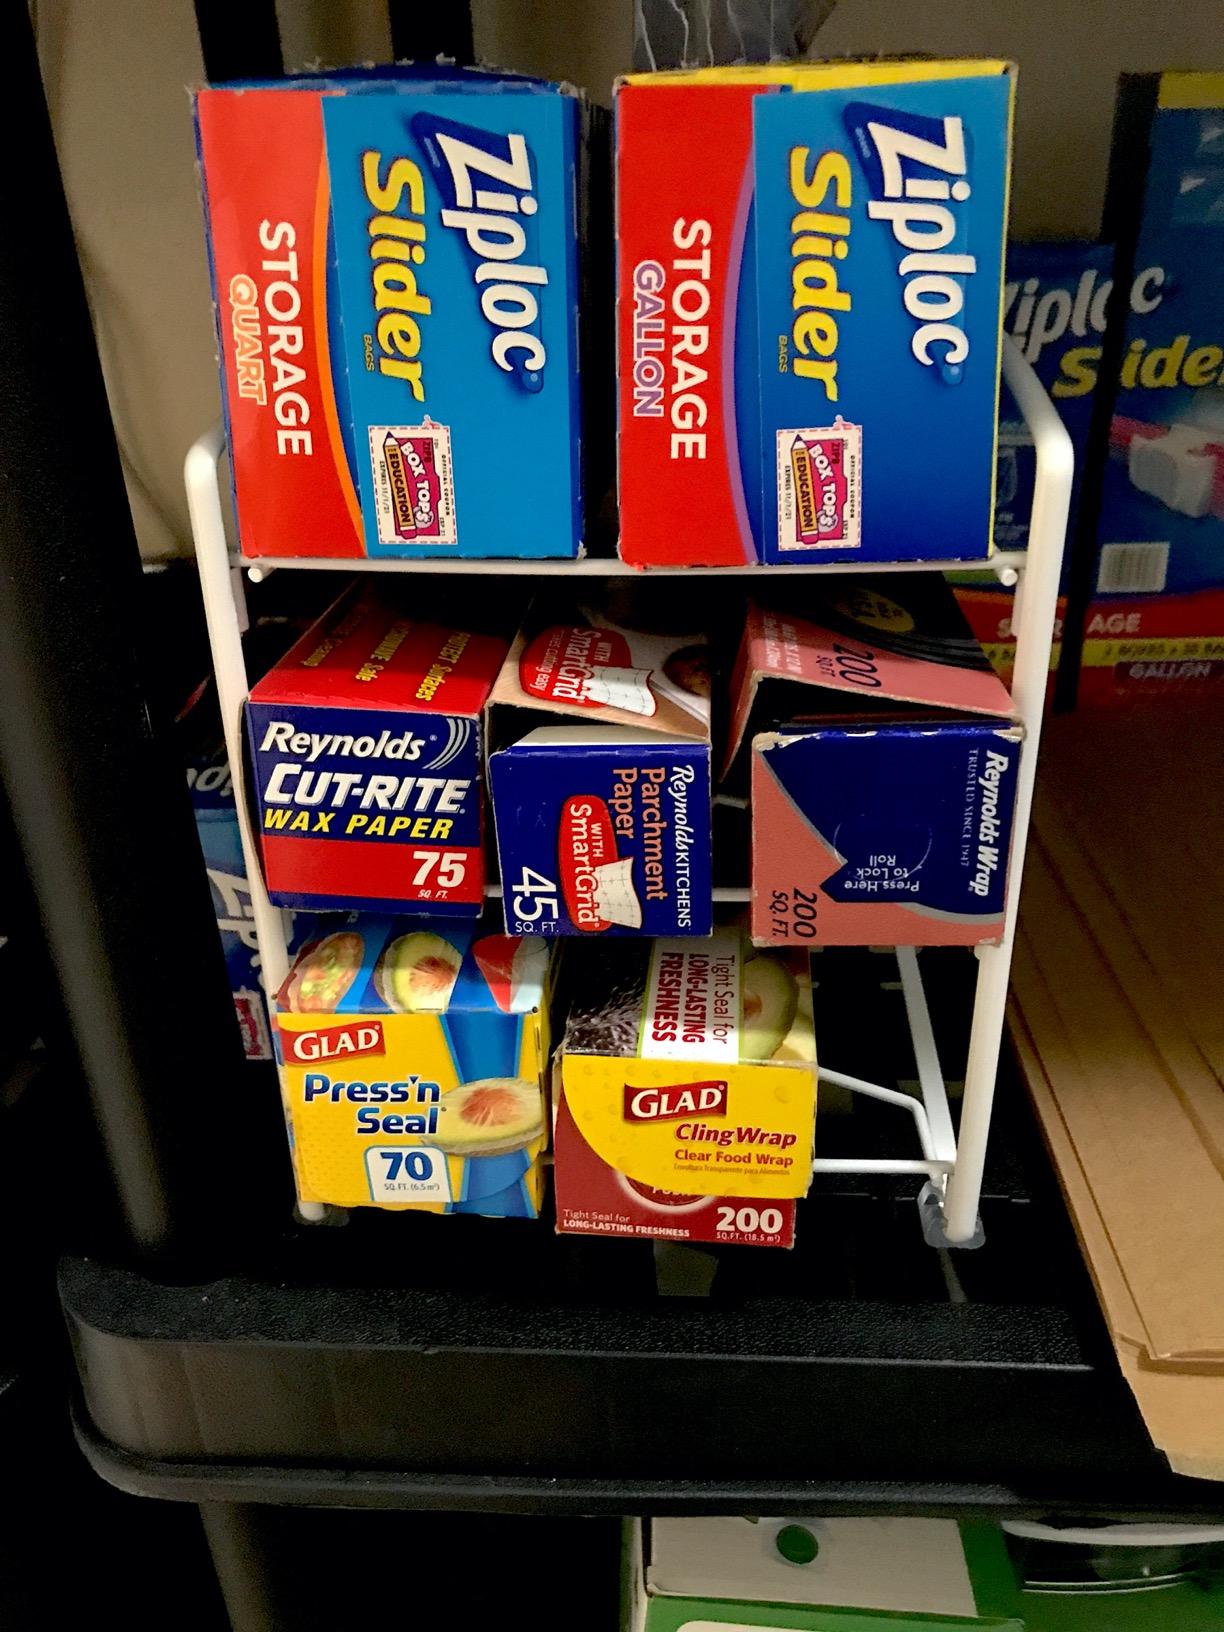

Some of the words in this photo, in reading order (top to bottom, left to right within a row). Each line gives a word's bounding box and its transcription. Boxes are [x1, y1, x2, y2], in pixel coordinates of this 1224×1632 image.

[435, 133, 549, 373] Ziploc
[866, 116, 977, 367] Ziploc
[361, 150, 433, 403] Slider
[788, 145, 852, 403] Slider
[228, 273, 268, 406] QUART
[258, 218, 314, 457] STORAGE
[364, 334, 375, 371] BAGS
[632, 259, 666, 417] GALLON
[670, 217, 712, 460] STORAGE
[778, 335, 788, 373] BAGS
[808, 444, 834, 481] BOX
[389, 453, 411, 523] EDUCATION
[400, 441, 426, 478] BOX
[414, 480, 432, 525] TOPS
[796, 457, 814, 528] EDUCATION
[819, 483, 837, 528] TOPS
[552, 628, 602, 699] SmartGrid
[593, 642, 612, 662] WITH
[833, 643, 883, 688] 200
[355, 662, 384, 682] Safe
[416, 664, 453, 701] Surfaces
[530, 673, 550, 692] easy
[258, 720, 426, 762] Reynolds
[263, 763, 471, 813] CUT-RITE
[965, 747, 979, 802] TRUSTED
[612, 767, 638, 839] Paper
[669, 764, 695, 852] Reynolds
[977, 749, 1009, 844] Reynolds
[263, 808, 335, 833] WAX
[345, 814, 454, 839] PAPER
[590, 823, 603, 858] WITH
[640, 767, 668, 901] Parchment
[961, 806, 975, 839] SINCE
[412, 850, 468, 888] 75
[568, 803, 600, 925] SmartGrid
[856, 867, 889, 878] Lock
[869, 855, 896, 867] Roll
[896, 867, 909, 878] to
[970, 845, 999, 897] Wrap
[511, 866, 560, 922] 45
[675, 852, 692, 929] KITCHENS
[771, 890, 788, 915] SQ.
[844, 880, 878, 892] Here
[878, 878, 920, 893] Press
[514, 921, 538, 934] SQ.
[541, 921, 559, 933] FT.
[771, 917, 788, 937] FT.
[792, 888, 818, 938] 200
[712, 954, 736, 989] Tight
[651, 952, 684, 1042] FRESHNESS
[681, 953, 709, 1043] LONG-LASTING
[714, 991, 733, 1021] Seal
[293, 1026, 380, 1061] GLAD
[712, 1024, 728, 1045] for
[304, 1074, 441, 1103] Press'n
[631, 1087, 722, 1118] GLAD
[356, 1107, 439, 1135] Seal
[380, 1151, 433, 1182] 70
[674, 1149, 713, 1162] Clear
[715, 1151, 752, 1164] Food
[755, 1153, 794, 1167] Wrap
[563, 1220, 633, 1233] LONG-LASTING
[635, 1225, 690, 1237] FRESHNESS
[564, 1209, 590, 1221] Tight
[592, 1210, 612, 1221] Seal
[615, 1212, 630, 1223] for
[715, 1206, 783, 1234] 200
